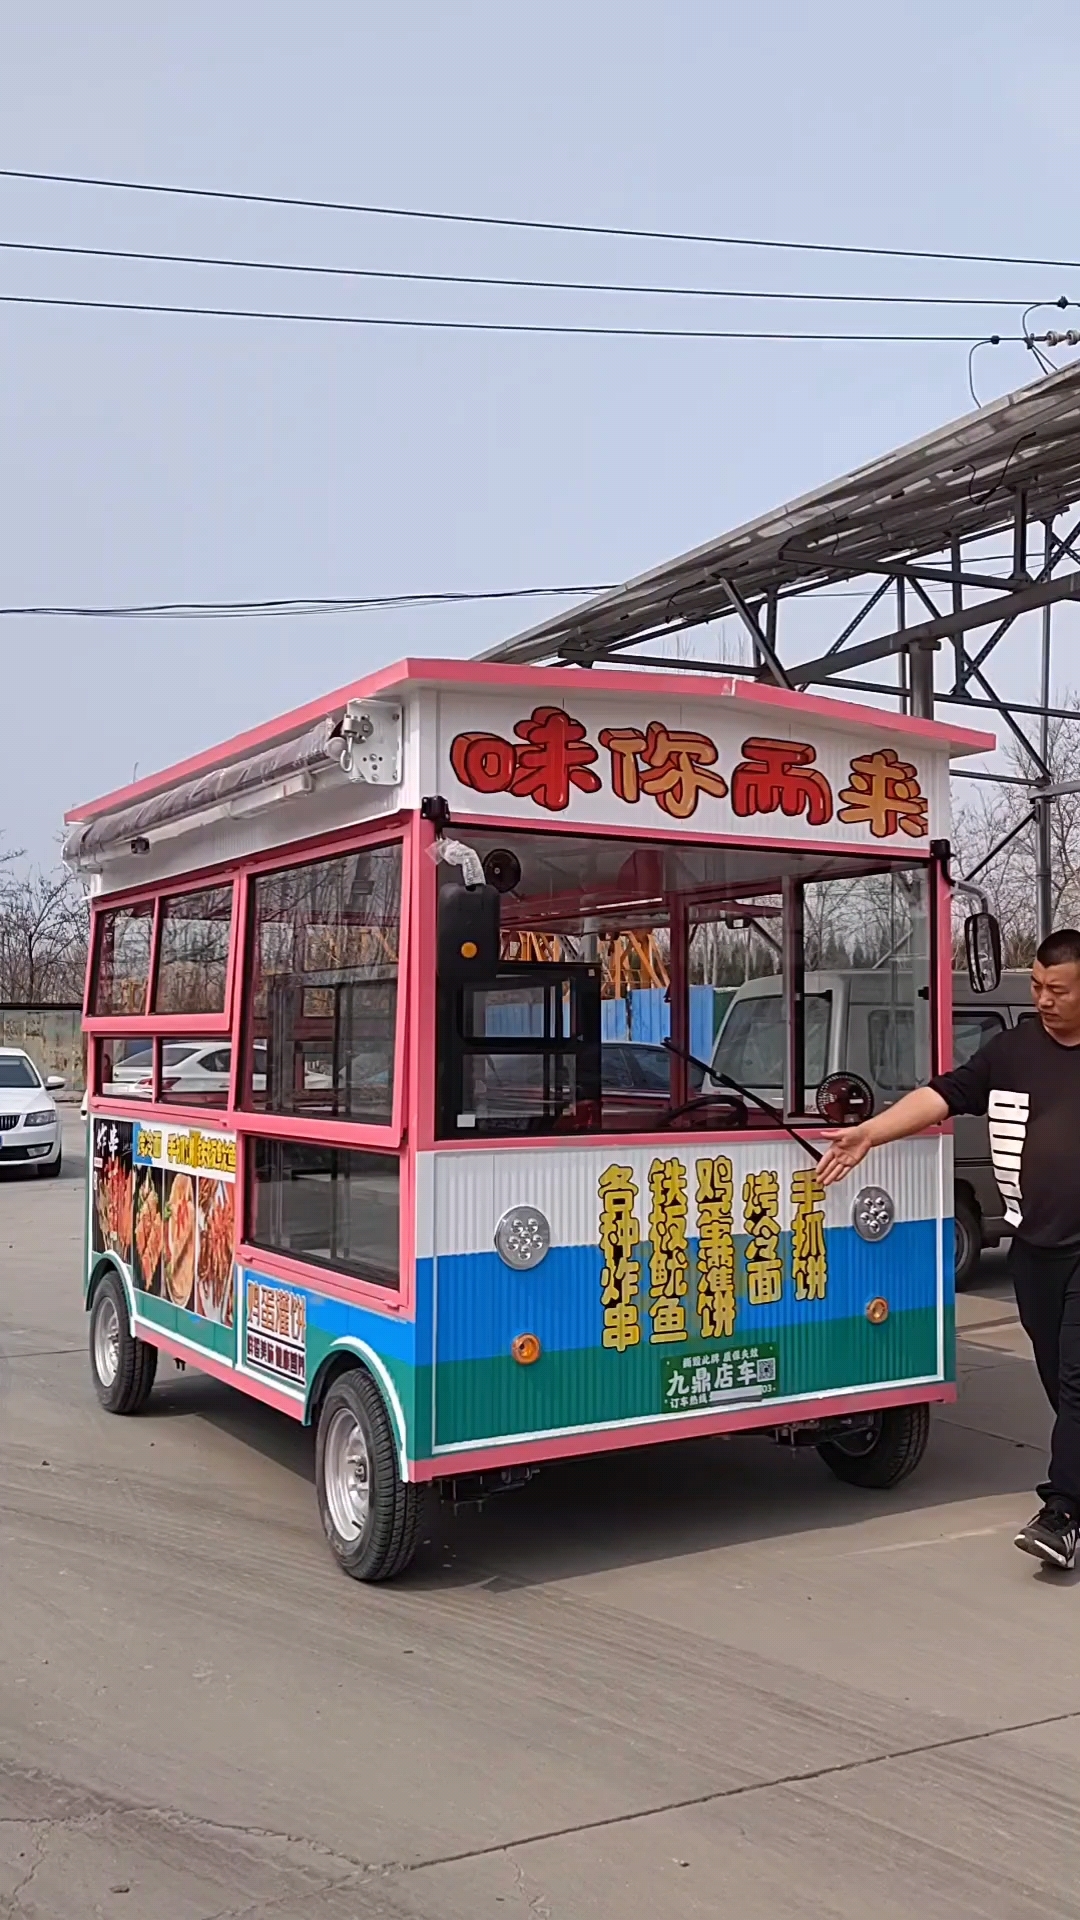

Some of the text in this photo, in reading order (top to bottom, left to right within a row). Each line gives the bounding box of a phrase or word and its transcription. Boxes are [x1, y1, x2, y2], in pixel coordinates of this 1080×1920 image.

[450, 706, 929, 838] 味你而来
[598, 1164, 640, 1352] 各种炸串
[649, 1157, 688, 1344] 铁板鱿鱼
[695, 1155, 735, 1338] 鸡蛋灌饼
[742, 1170, 782, 1305] 烤冷面
[790, 1168, 827, 1301] 手抓饼
[666, 1360, 757, 1397] 九鼎店车
[670, 1393, 708, 1409] 订车热线
